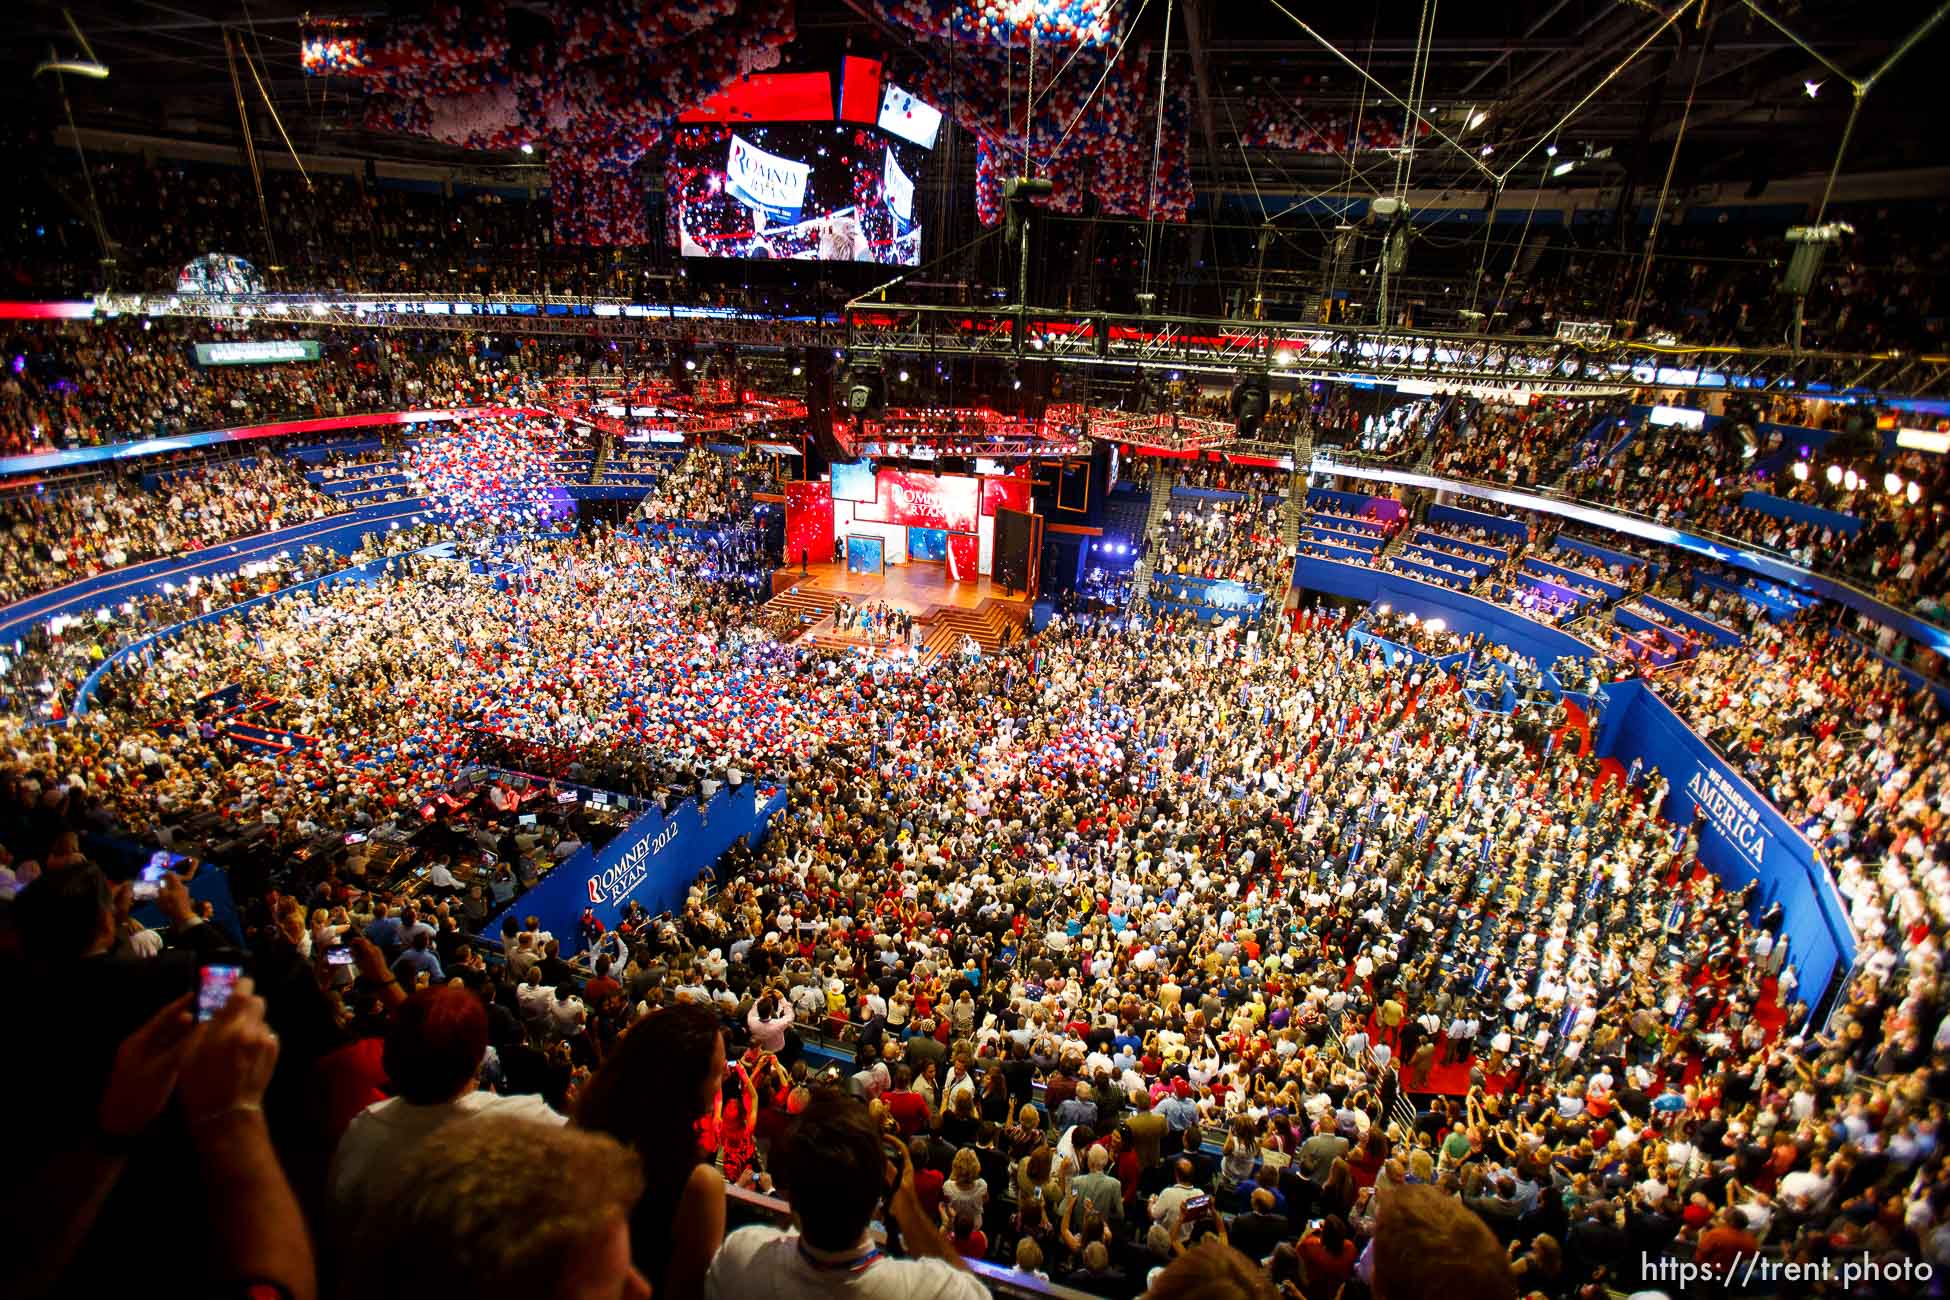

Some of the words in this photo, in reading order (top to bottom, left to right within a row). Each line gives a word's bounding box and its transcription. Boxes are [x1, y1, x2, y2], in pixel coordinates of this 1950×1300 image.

[911, 504, 945, 519] RYAN
[1687, 772, 1765, 863] AMERICA
[1709, 768, 1722, 786] WE
[1748, 808, 1760, 825] IN
[588, 833, 651, 903] ROMNEY
[652, 821, 679, 855] 2012
[611, 859, 647, 899] RYAN
